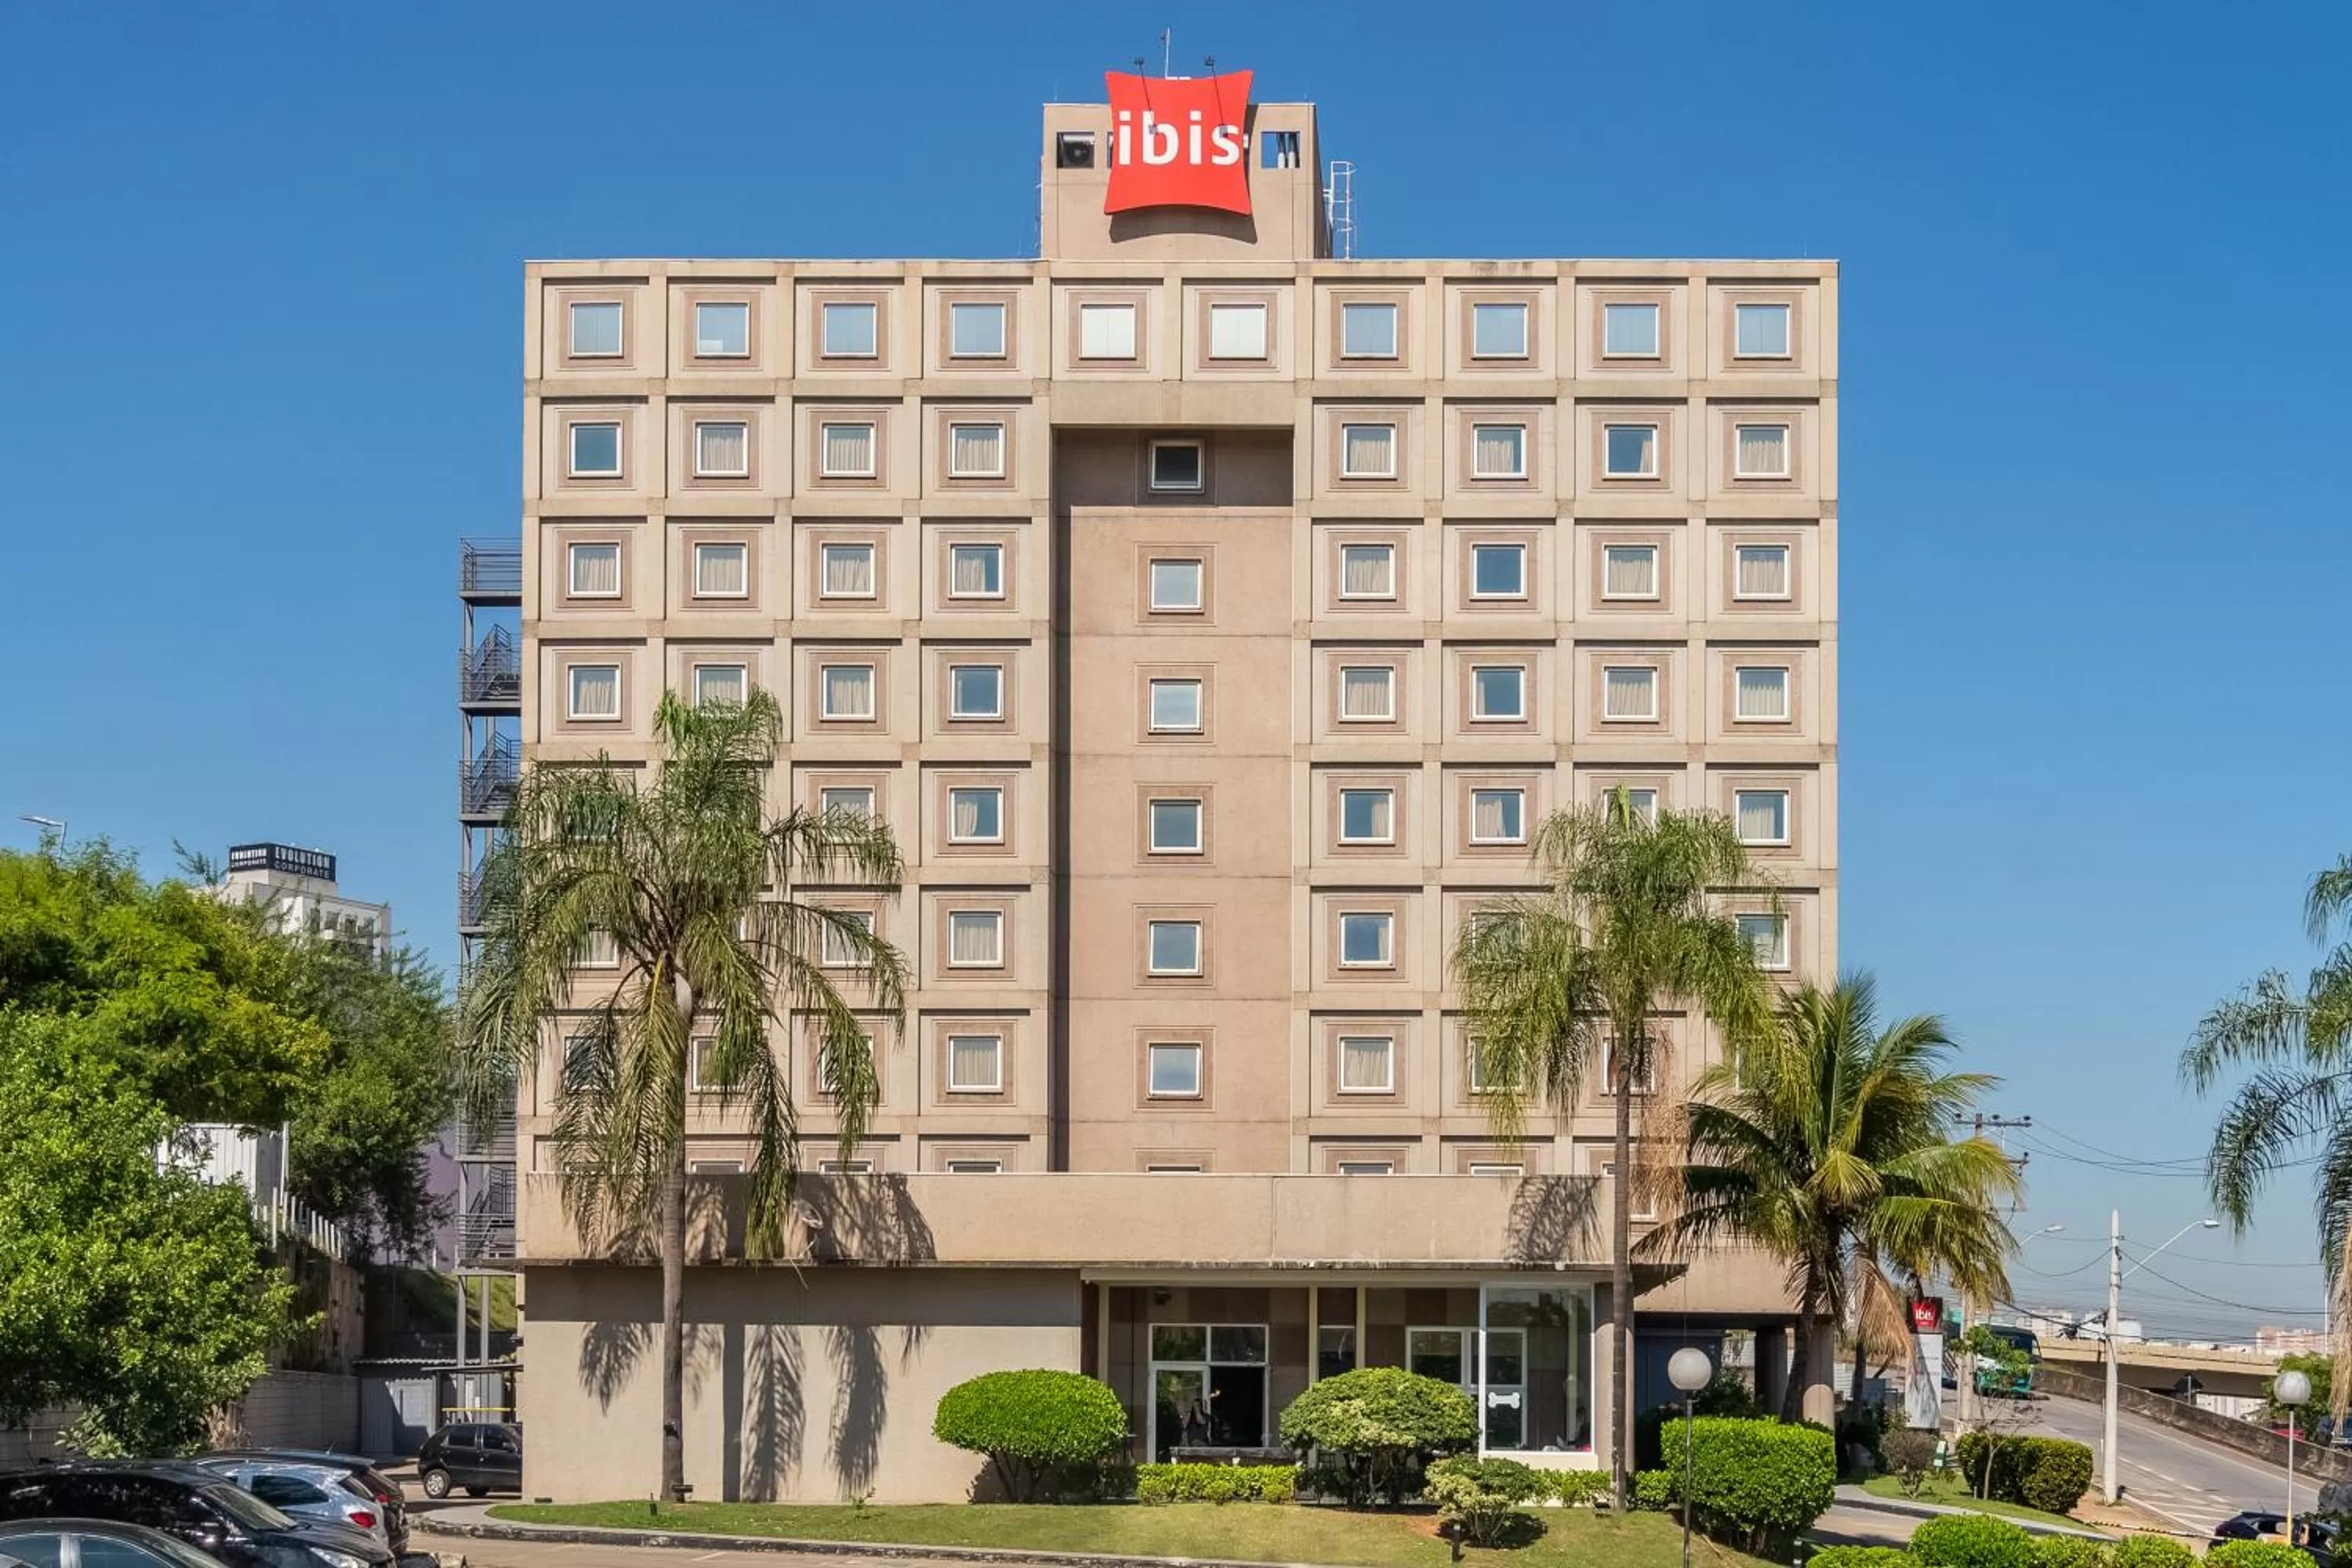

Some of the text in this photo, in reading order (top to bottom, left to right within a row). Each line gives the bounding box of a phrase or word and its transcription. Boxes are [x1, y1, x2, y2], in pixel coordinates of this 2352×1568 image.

[1119, 111, 1240, 165] ibis
[275, 847, 329, 869] EVOLUTION
[274, 861, 329, 879] CORPORATE
[1915, 1308, 1934, 1321] ibis
